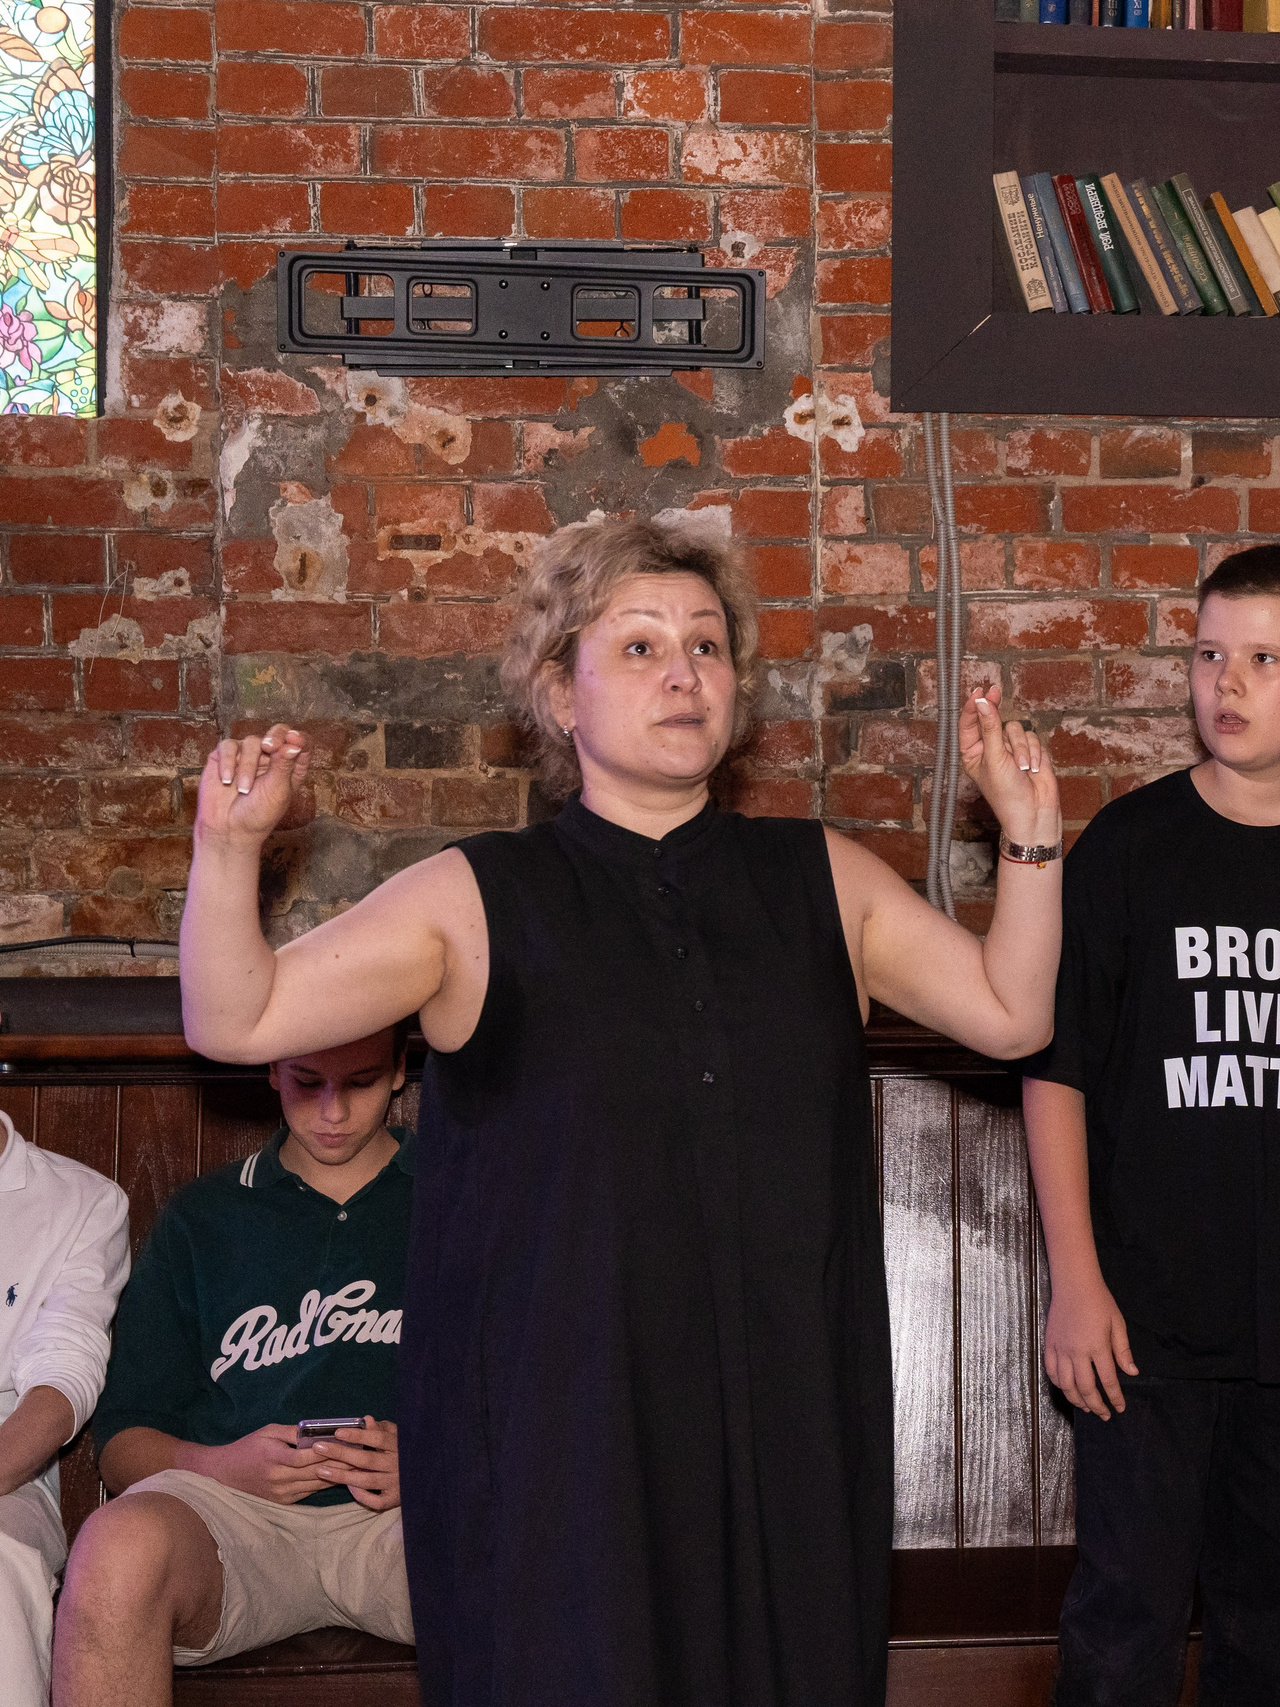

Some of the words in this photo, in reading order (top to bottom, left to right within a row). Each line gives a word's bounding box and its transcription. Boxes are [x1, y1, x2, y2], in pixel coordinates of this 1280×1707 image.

[1007, 211, 1029, 271] ПОСЛЕДНИЕ
[1015, 209, 1038, 269] КАРОЛИНГИ
[1027, 192, 1045, 239] Ненужные
[1098, 230, 1114, 251] РЭЙ
